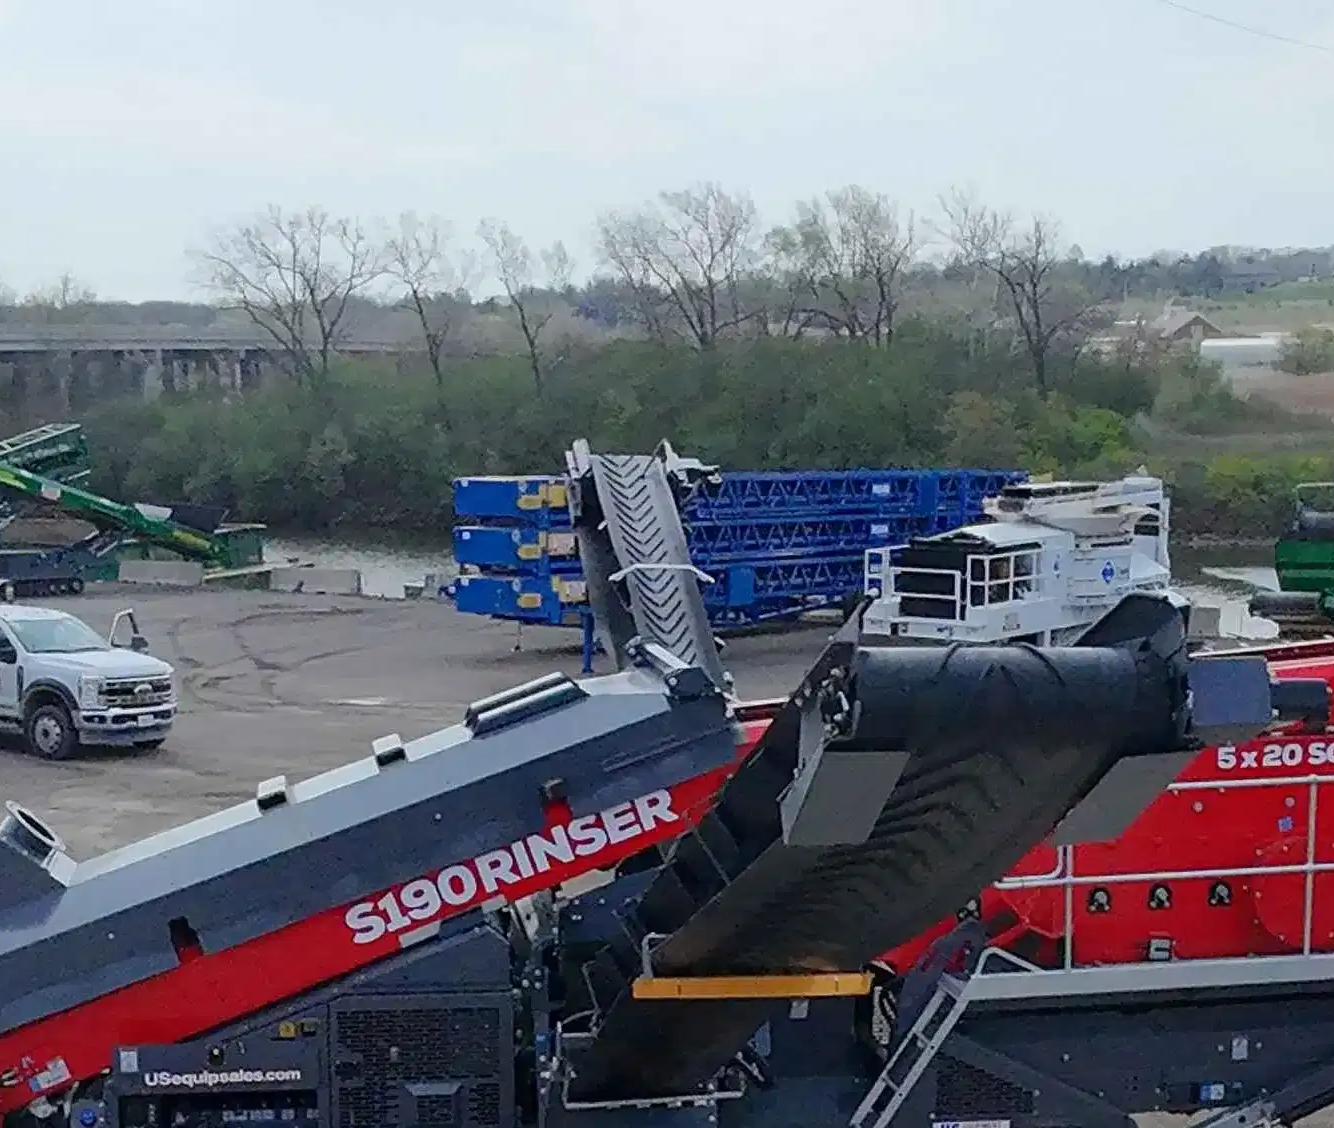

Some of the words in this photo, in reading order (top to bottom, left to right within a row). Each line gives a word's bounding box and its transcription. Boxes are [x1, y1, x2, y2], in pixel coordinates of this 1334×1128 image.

[1217, 746, 1237, 769] 5
[1240, 751, 1258, 768] x
[1263, 744, 1303, 767] 20
[144, 1069, 301, 1087] USequipsales.com
